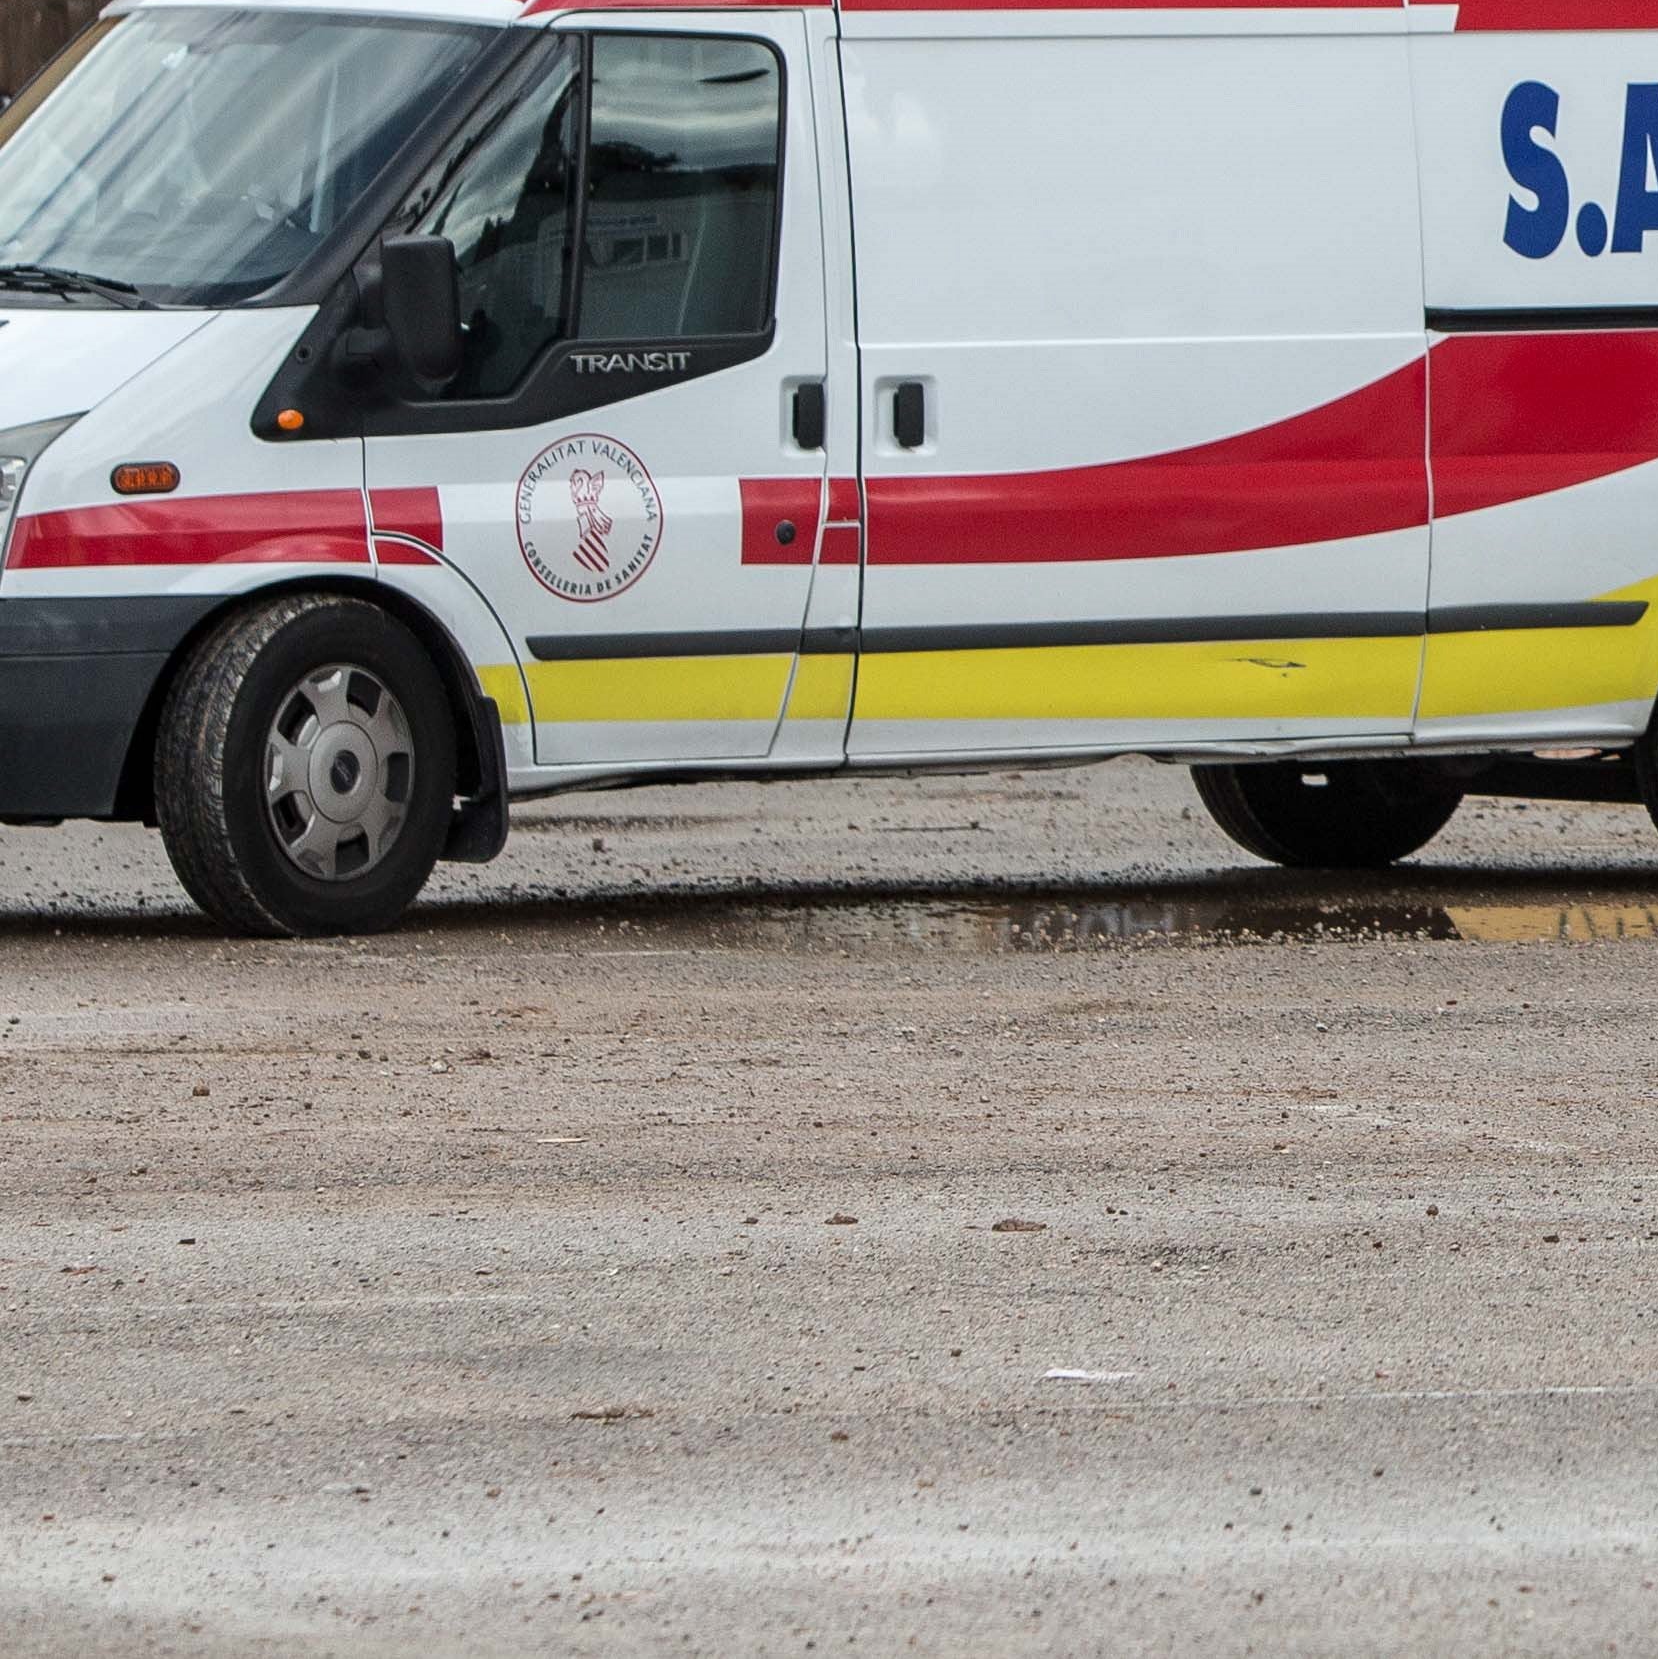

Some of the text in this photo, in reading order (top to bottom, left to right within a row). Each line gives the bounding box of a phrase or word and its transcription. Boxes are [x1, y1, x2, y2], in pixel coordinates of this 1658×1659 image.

[570, 351, 691, 373] TRANSIT
[519, 440, 658, 525] GENERALITAT VALENCIANA
[524, 533, 653, 595] CONSELLERIA DE SANITAT
